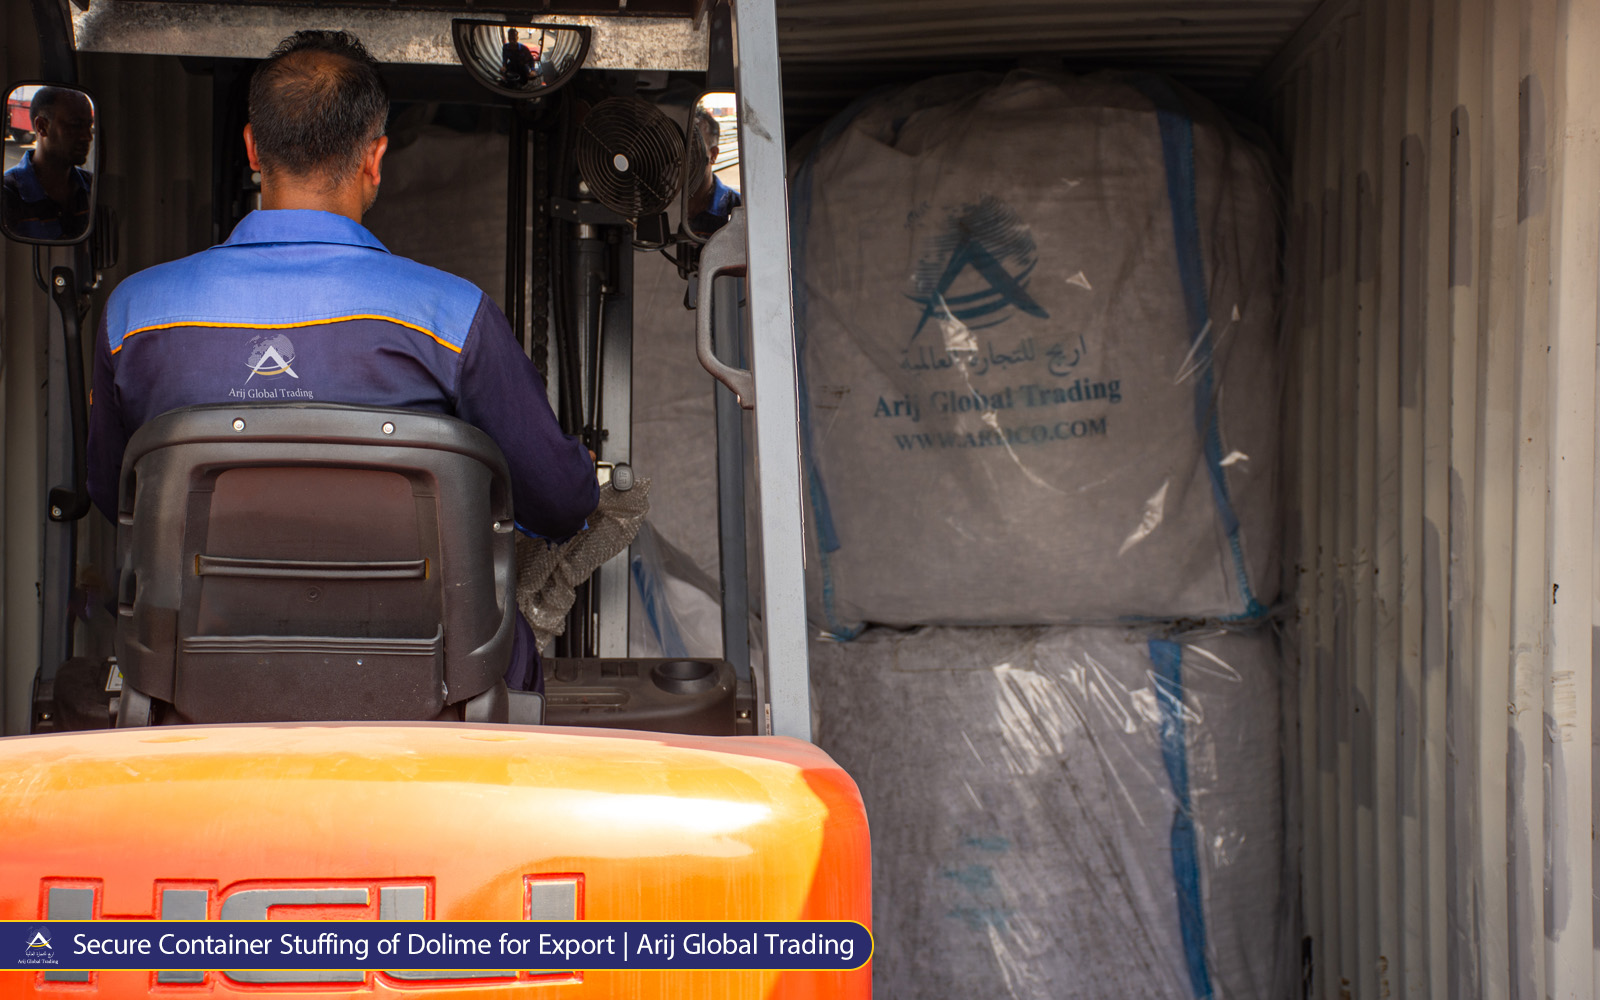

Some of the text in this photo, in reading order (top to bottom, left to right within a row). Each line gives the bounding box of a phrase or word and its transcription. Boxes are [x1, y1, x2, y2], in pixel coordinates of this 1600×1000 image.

[228, 388, 314, 400] Arij Global Trading
[874, 377, 1123, 423] Arij Global Trading
